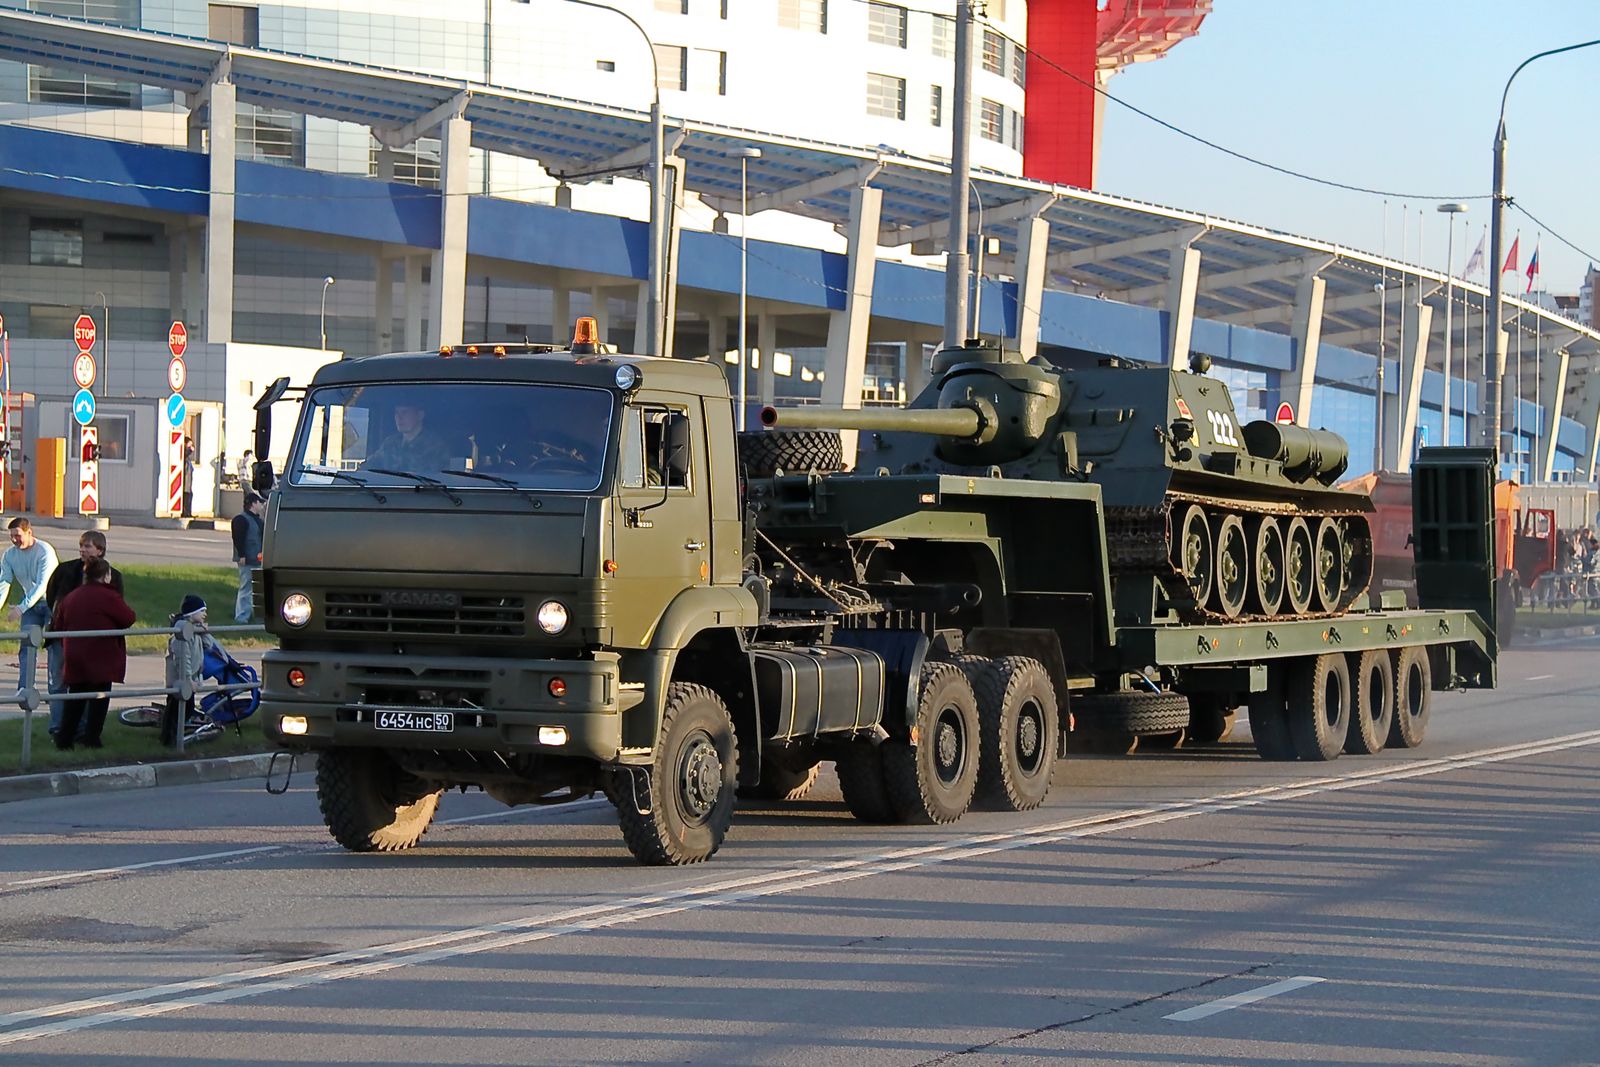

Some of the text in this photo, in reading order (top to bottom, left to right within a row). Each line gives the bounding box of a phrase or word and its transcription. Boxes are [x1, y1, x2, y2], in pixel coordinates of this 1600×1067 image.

[76, 328, 95, 340] STOP
[170, 334, 186, 346] STOP
[175, 368, 180, 381] 5
[1206, 409, 1239, 447] 222
[435, 714, 449, 726] 50
